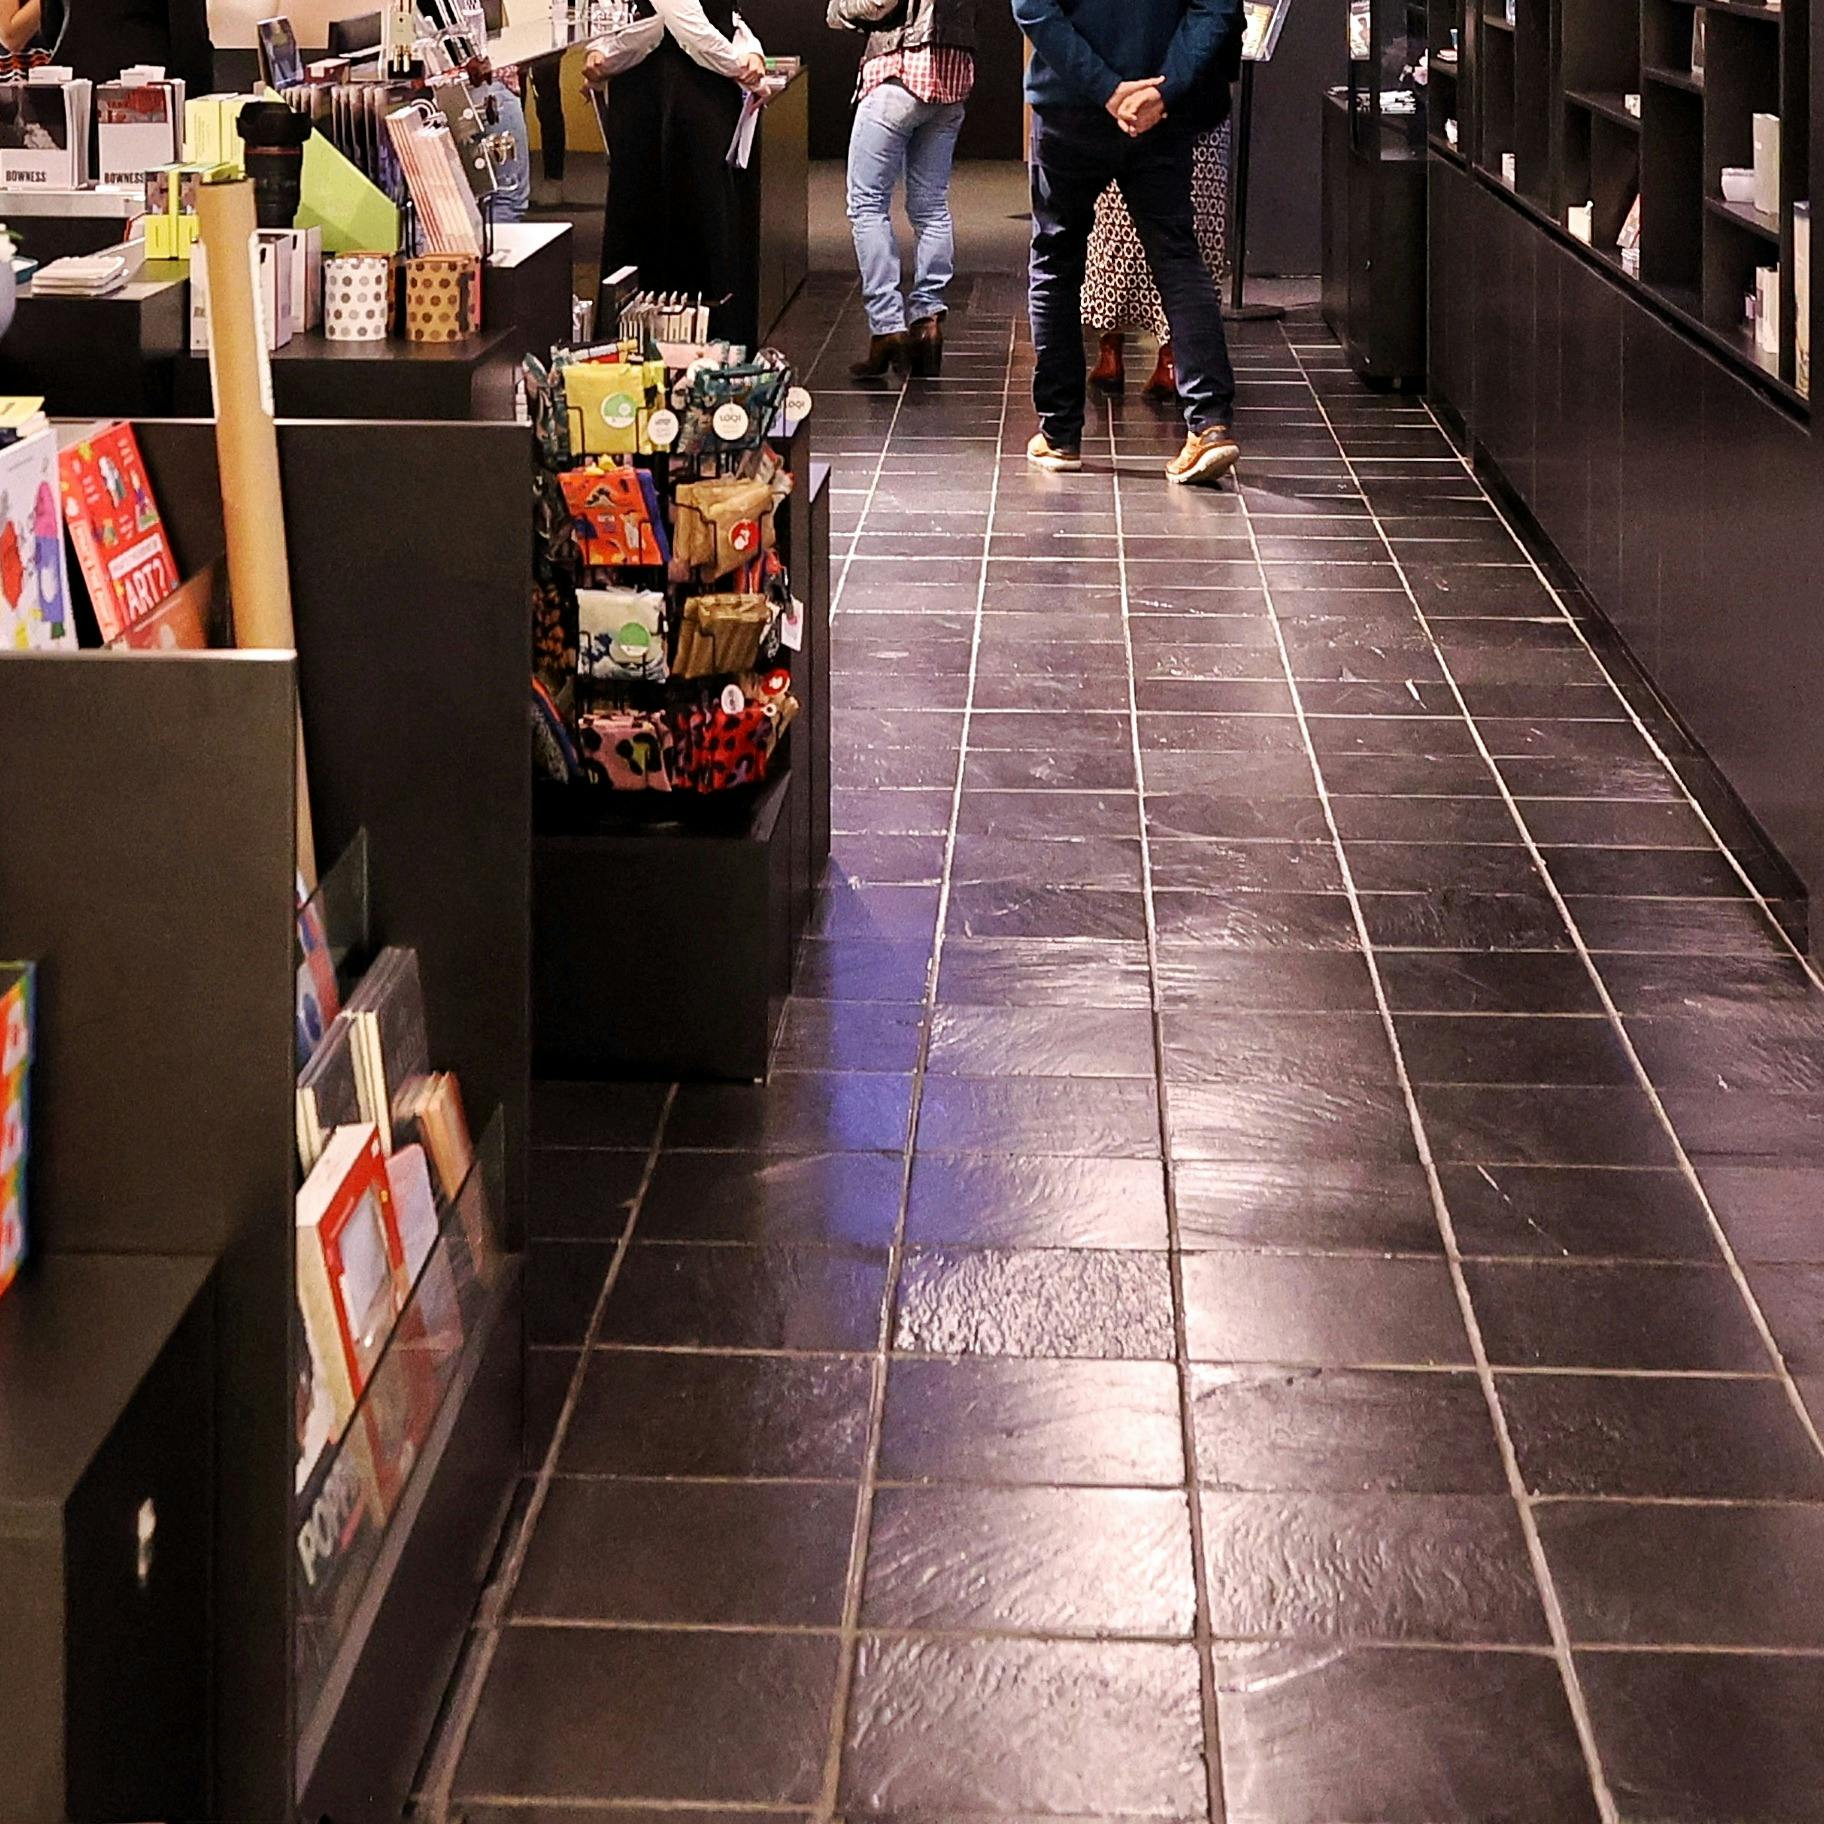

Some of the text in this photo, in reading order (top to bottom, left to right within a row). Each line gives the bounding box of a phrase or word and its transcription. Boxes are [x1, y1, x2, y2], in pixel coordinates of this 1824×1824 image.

[5, 171, 47, 184] BOWNESS
[104, 172, 146, 185] BOWNESS
[789, 400, 805, 409] OQI
[720, 413, 742, 424] LOQI
